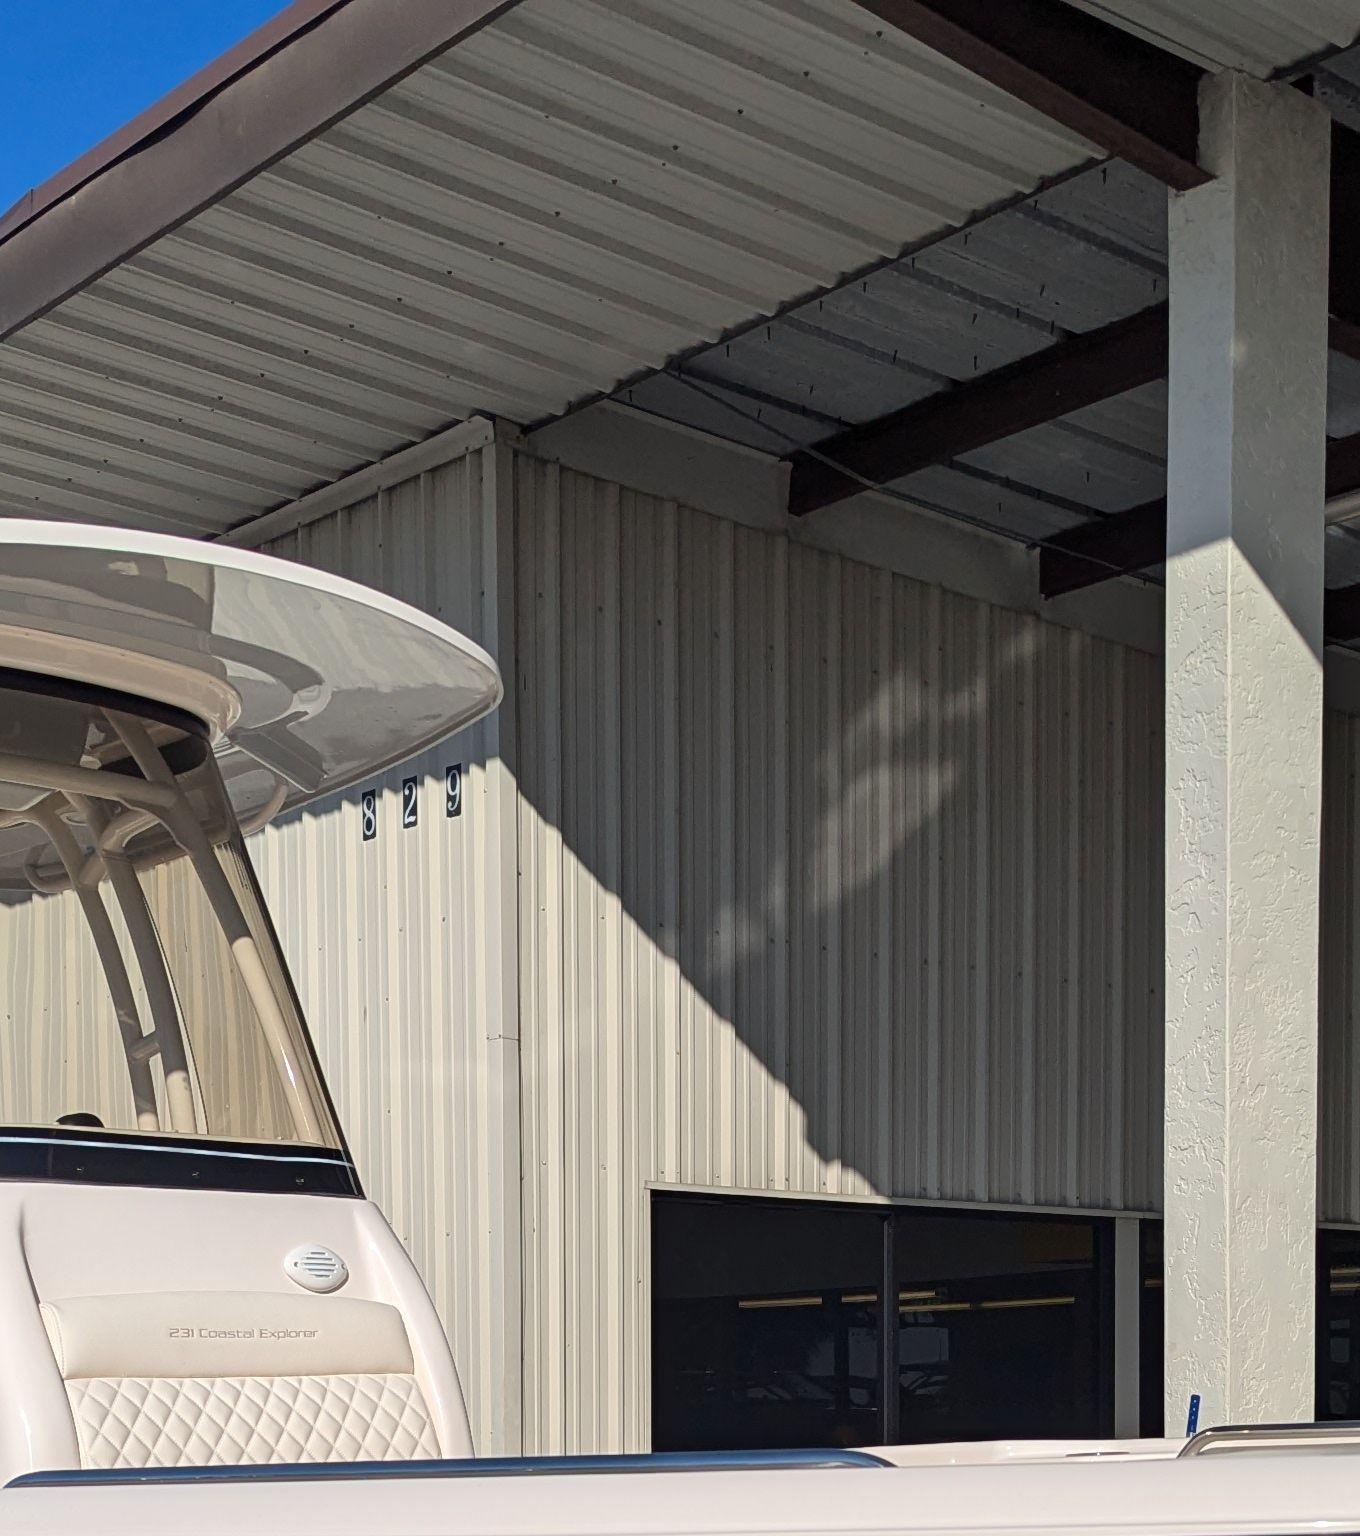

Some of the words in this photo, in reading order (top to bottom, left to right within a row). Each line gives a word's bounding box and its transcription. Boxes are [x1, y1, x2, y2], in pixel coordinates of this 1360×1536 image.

[363, 769, 461, 836] 829
[168, 1327, 195, 1339] 231
[198, 1327, 255, 1339] Coastal
[259, 1327, 319, 1341] Explorer
